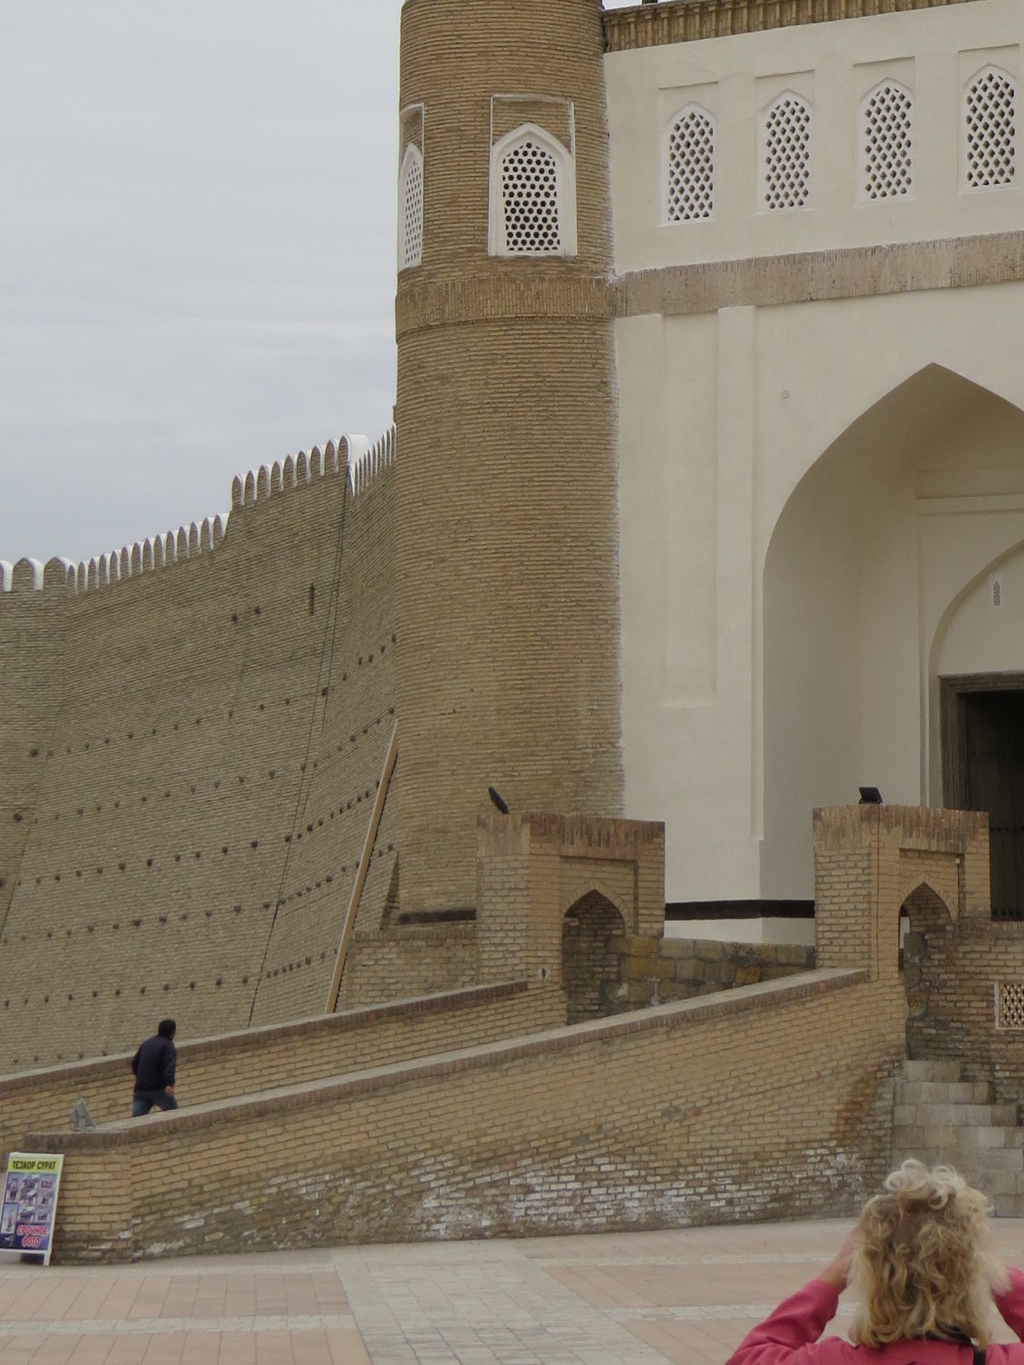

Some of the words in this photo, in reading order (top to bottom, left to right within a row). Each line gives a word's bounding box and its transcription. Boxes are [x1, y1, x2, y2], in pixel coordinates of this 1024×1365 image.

[12, 1161, 36, 1171] ТЕЗКОР
[37, 1161, 56, 1170] СУРАТ
[17, 1226, 47, 1236] СРОЧНОЕ
[22, 1237, 41, 1247] ФОТО
